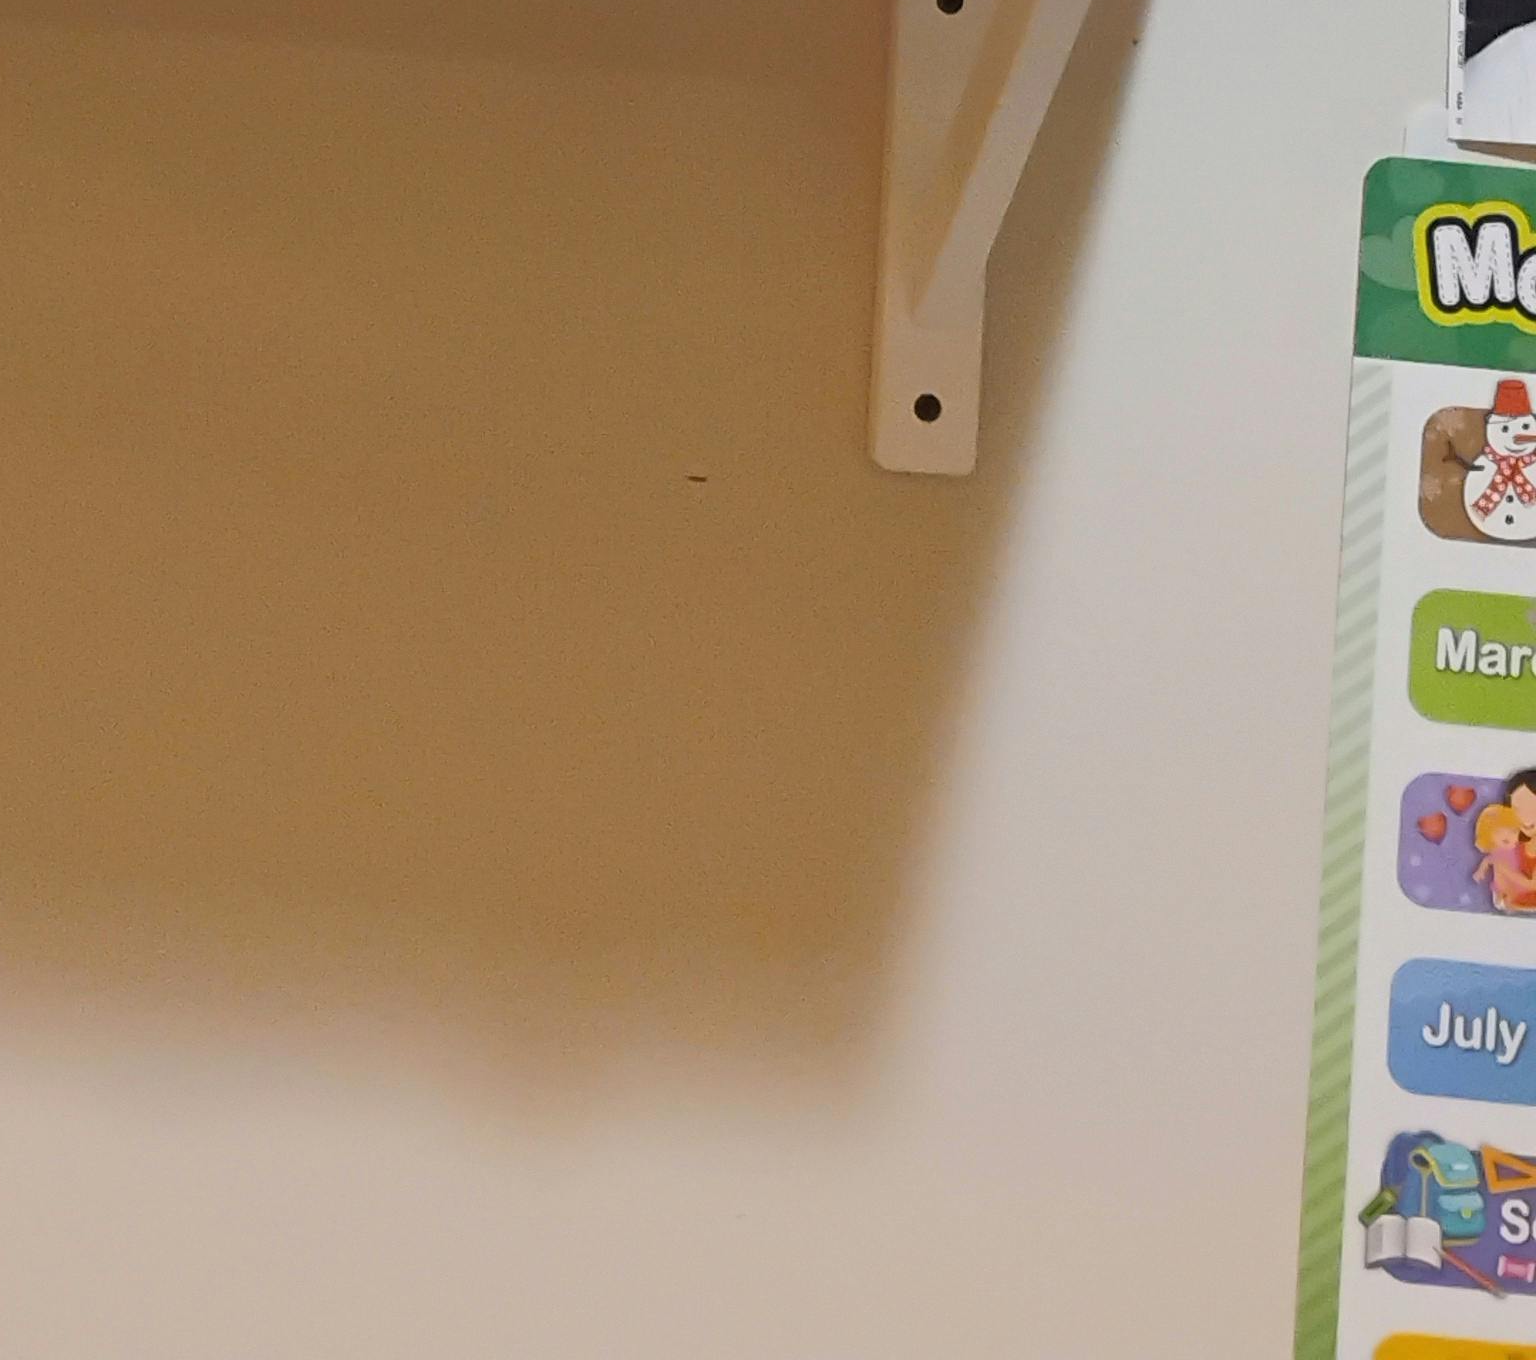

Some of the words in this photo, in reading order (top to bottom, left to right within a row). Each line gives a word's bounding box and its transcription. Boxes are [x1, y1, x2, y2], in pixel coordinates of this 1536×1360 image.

[1435, 626, 1536, 679] Mar
[1421, 1000, 1528, 1065] July
[1499, 1198, 1536, 1245] S
